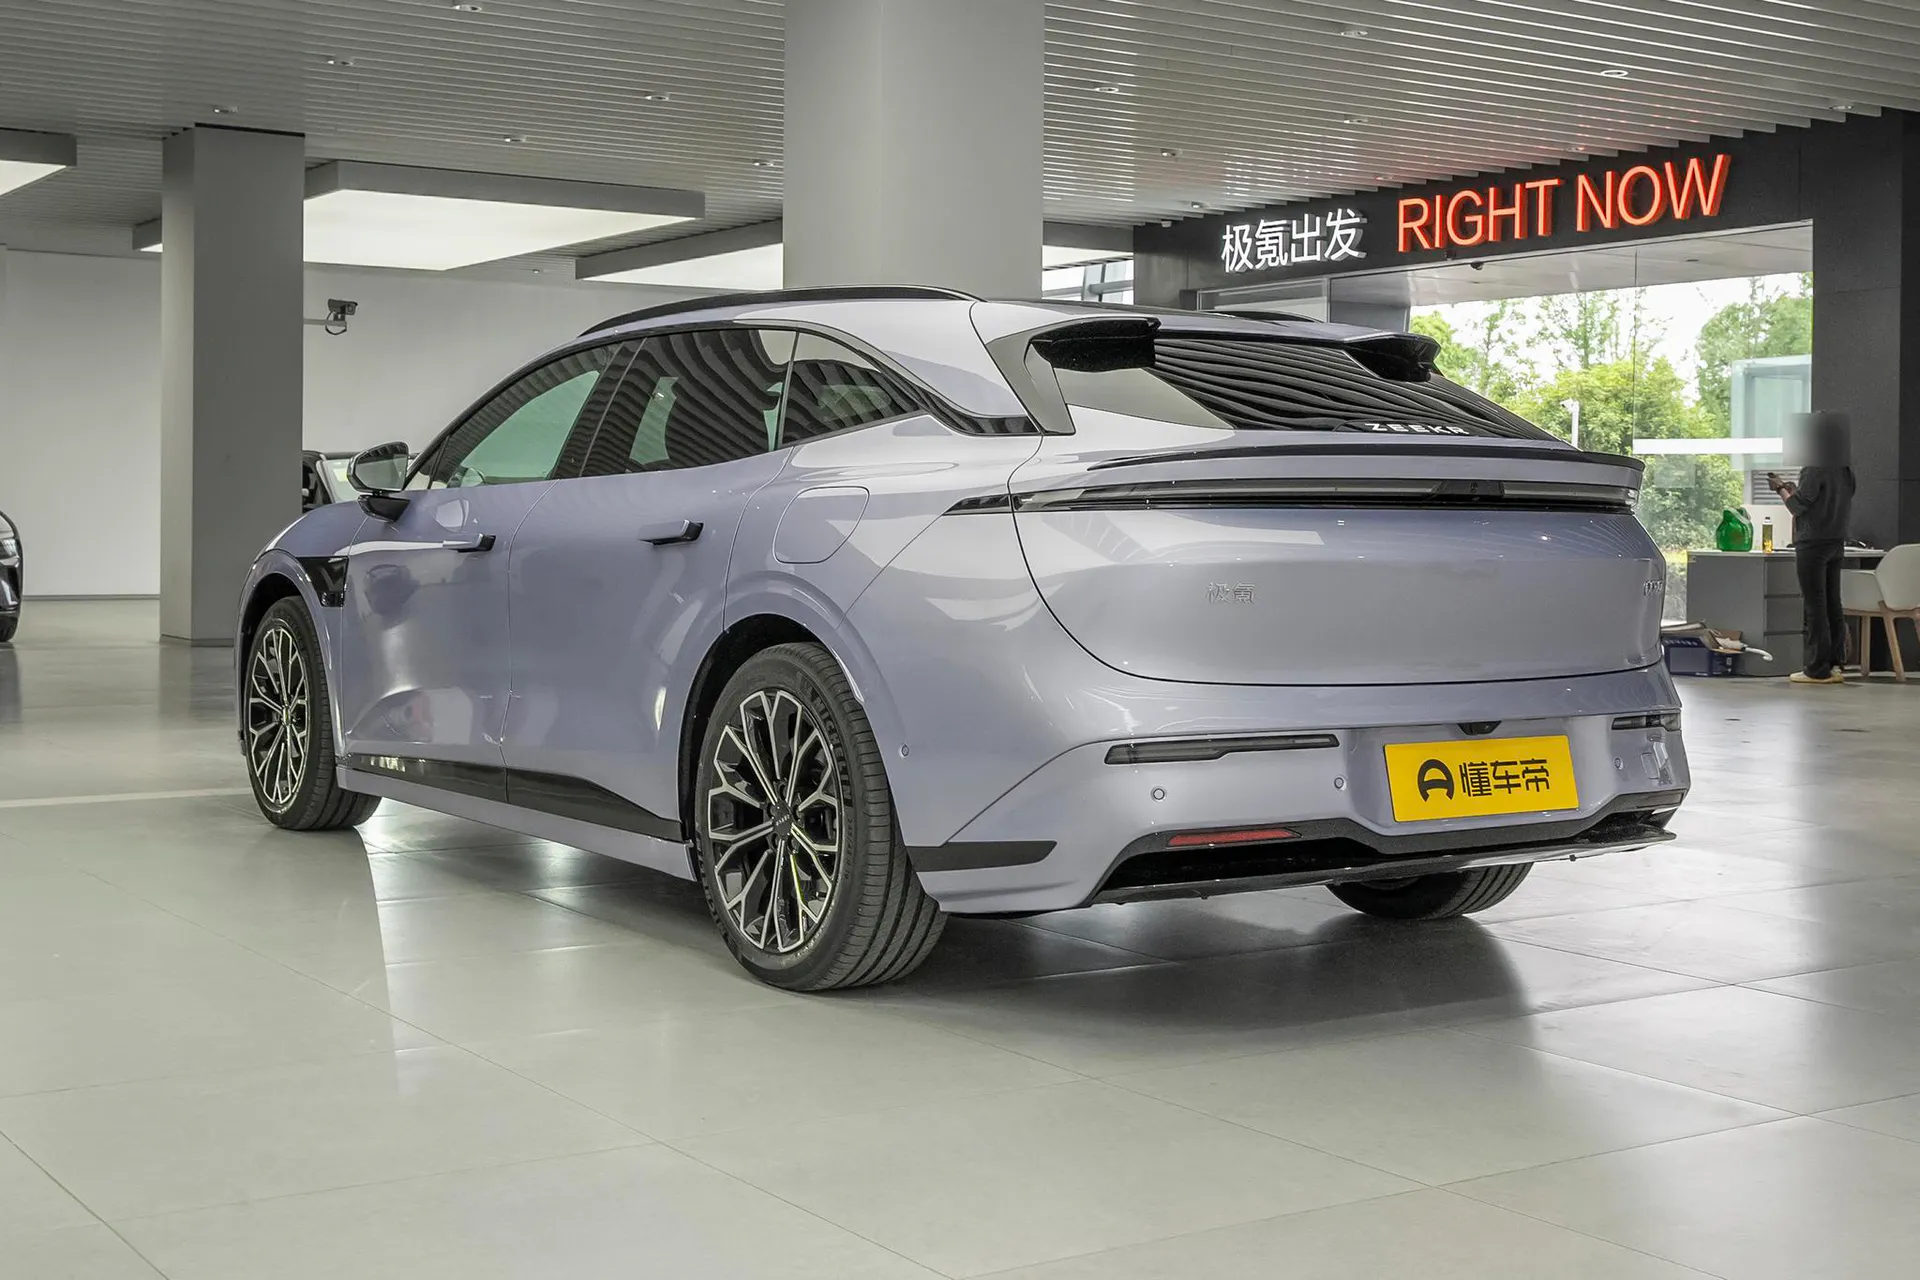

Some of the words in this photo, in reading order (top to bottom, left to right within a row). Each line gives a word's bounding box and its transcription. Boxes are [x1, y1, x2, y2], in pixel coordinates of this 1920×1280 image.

[1398, 178, 1564, 253] RIGHT
[1577, 154, 1731, 233] NOW
[1221, 208, 1366, 273] 极氪出发
[1364, 422, 1470, 435] ZEEKR
